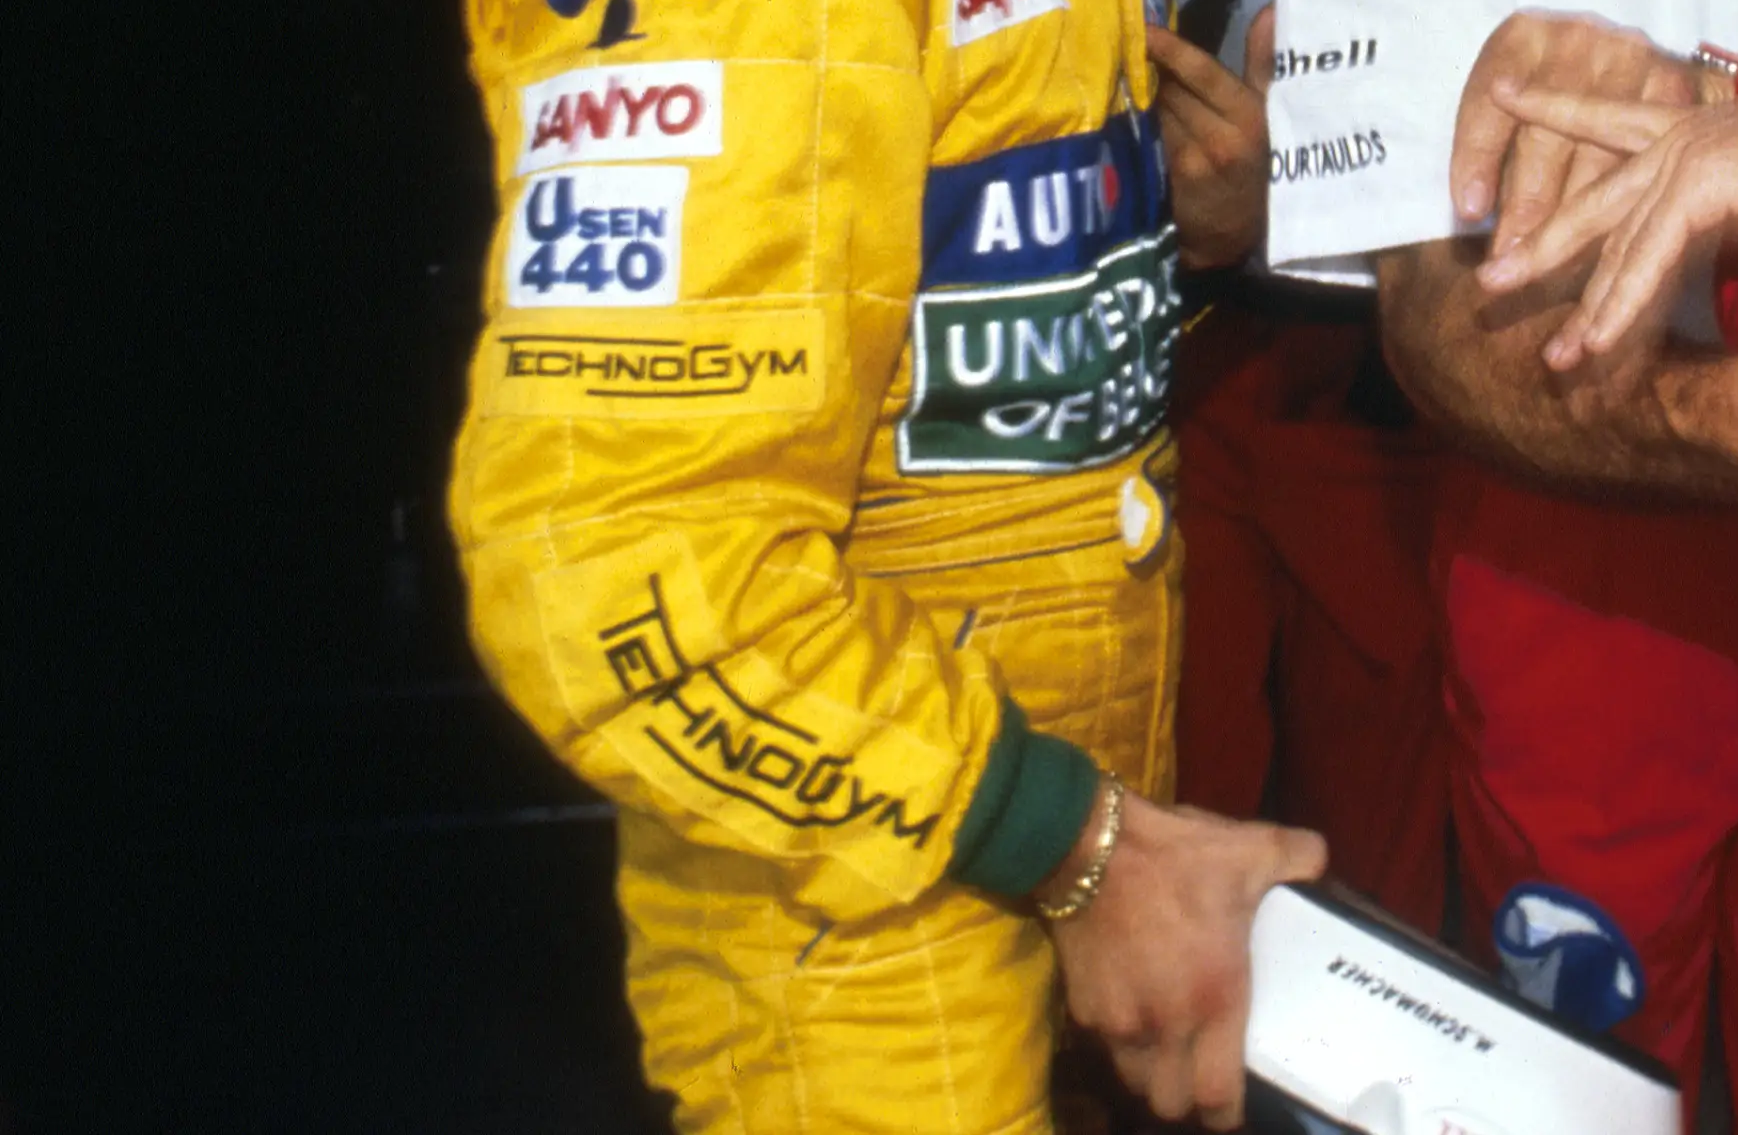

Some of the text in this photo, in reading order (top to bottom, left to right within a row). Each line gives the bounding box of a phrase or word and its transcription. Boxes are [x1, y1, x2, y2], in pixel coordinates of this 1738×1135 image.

[1270, 129, 1388, 185] OURTAULDS
[974, 165, 1115, 255] AUT
[519, 241, 667, 295] 440
[981, 390, 1094, 442] OF
[597, 572, 941, 850] TEHNOGYM
